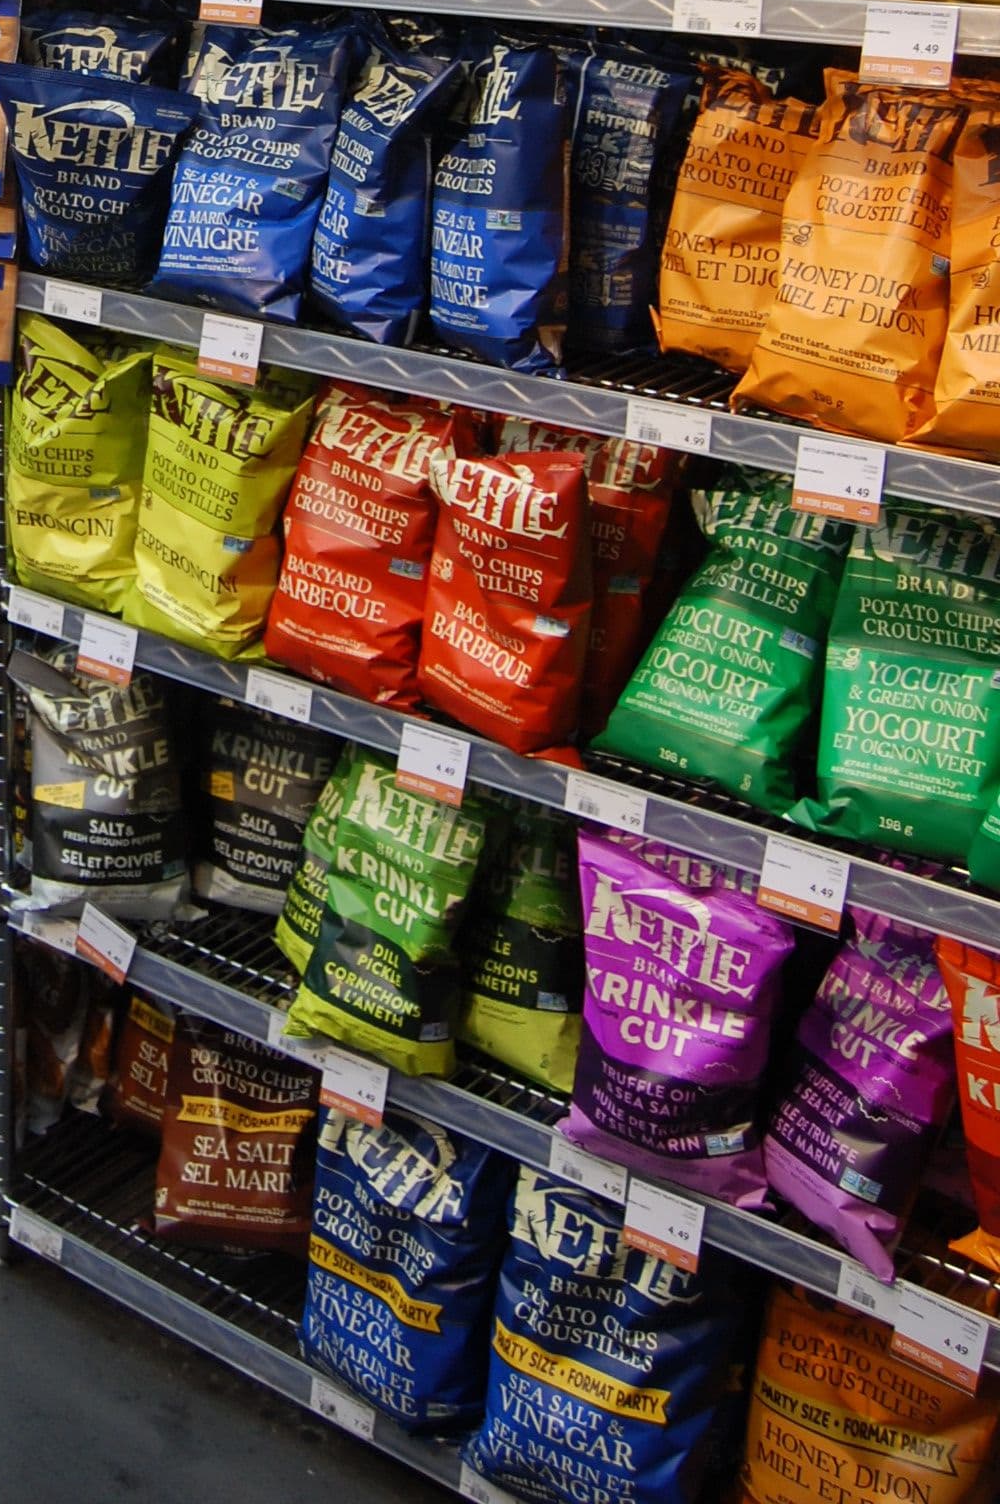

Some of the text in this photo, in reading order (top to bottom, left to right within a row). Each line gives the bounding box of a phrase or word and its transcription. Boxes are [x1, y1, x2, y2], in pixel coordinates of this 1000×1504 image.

[912, 42, 939, 55] 4.49
[188, 42, 325, 113] KETTLE
[220, 113, 276, 131] BRAND
[713, 124, 785, 155] BRAND
[252, 136, 300, 157] CHIPS
[57, 170, 121, 190] BRAND
[821, 175, 895, 202] POTATO
[696, 262, 726, 282] ET
[782, 257, 855, 293] HONEY
[823, 296, 926, 338] ET DIJON
[175, 440, 219, 471] BRAND
[153, 453, 240, 506] POTATO CHIPS
[153, 469, 234, 523] CROUSTILLES
[331, 461, 383, 493] BRAND
[295, 494, 404, 545] CROUSTILLES
[298, 474, 409, 528] POTATO CHIPS
[287, 554, 373, 594] BACKYARD
[490, 558, 543, 586] CHIPS
[748, 557, 809, 598] CHIPS
[896, 573, 973, 599] BRAND
[859, 596, 940, 625] POTATO
[431, 612, 532, 688] BARBEQUE
[720, 643, 775, 675] ONION
[867, 659, 984, 701] YOGURT
[867, 687, 990, 723] GREEN ONION
[843, 705, 986, 757] YOGOURT
[832, 731, 987, 778] ET OIGNON VERT
[243, 767, 290, 799] CUT
[89, 819, 125, 837] SALT
[240, 812, 267, 834] SALT
[61, 848, 163, 869] SEL POIVRE
[374, 891, 422, 934] CUT
[372, 943, 400, 967] DILL
[585, 867, 756, 1001] KETTLE
[585, 963, 748, 1041] KRINKLE
[619, 1016, 698, 1058] CUT
[829, 1022, 882, 1069] CUT
[193, 1135, 294, 1165] SEA SALT
[181, 1161, 218, 1187] SEL
[316, 1187, 436, 1271] POTATO CHIPS
[332, 1253, 357, 1278] SIZE
[314, 1271, 391, 1330] SEA SALT
[550, 1275, 627, 1308] BRAND
[310, 1281, 415, 1372] VINEGAR
[514, 1302, 654, 1374] CROUSTILLES
[779, 1328, 872, 1372] POTATO
[508, 1373, 603, 1428] SEA SALT
[530, 1352, 660, 1416] SIZE FORMAT PARTY
[500, 1383, 636, 1471] VINEGAR
[761, 1382, 898, 1447] PARTY SIZE FORMAT
[492, 1420, 635, 1496] SEL MARIN ET
[756, 1440, 810, 1489] MIEL
[765, 1420, 848, 1478] HONEY
